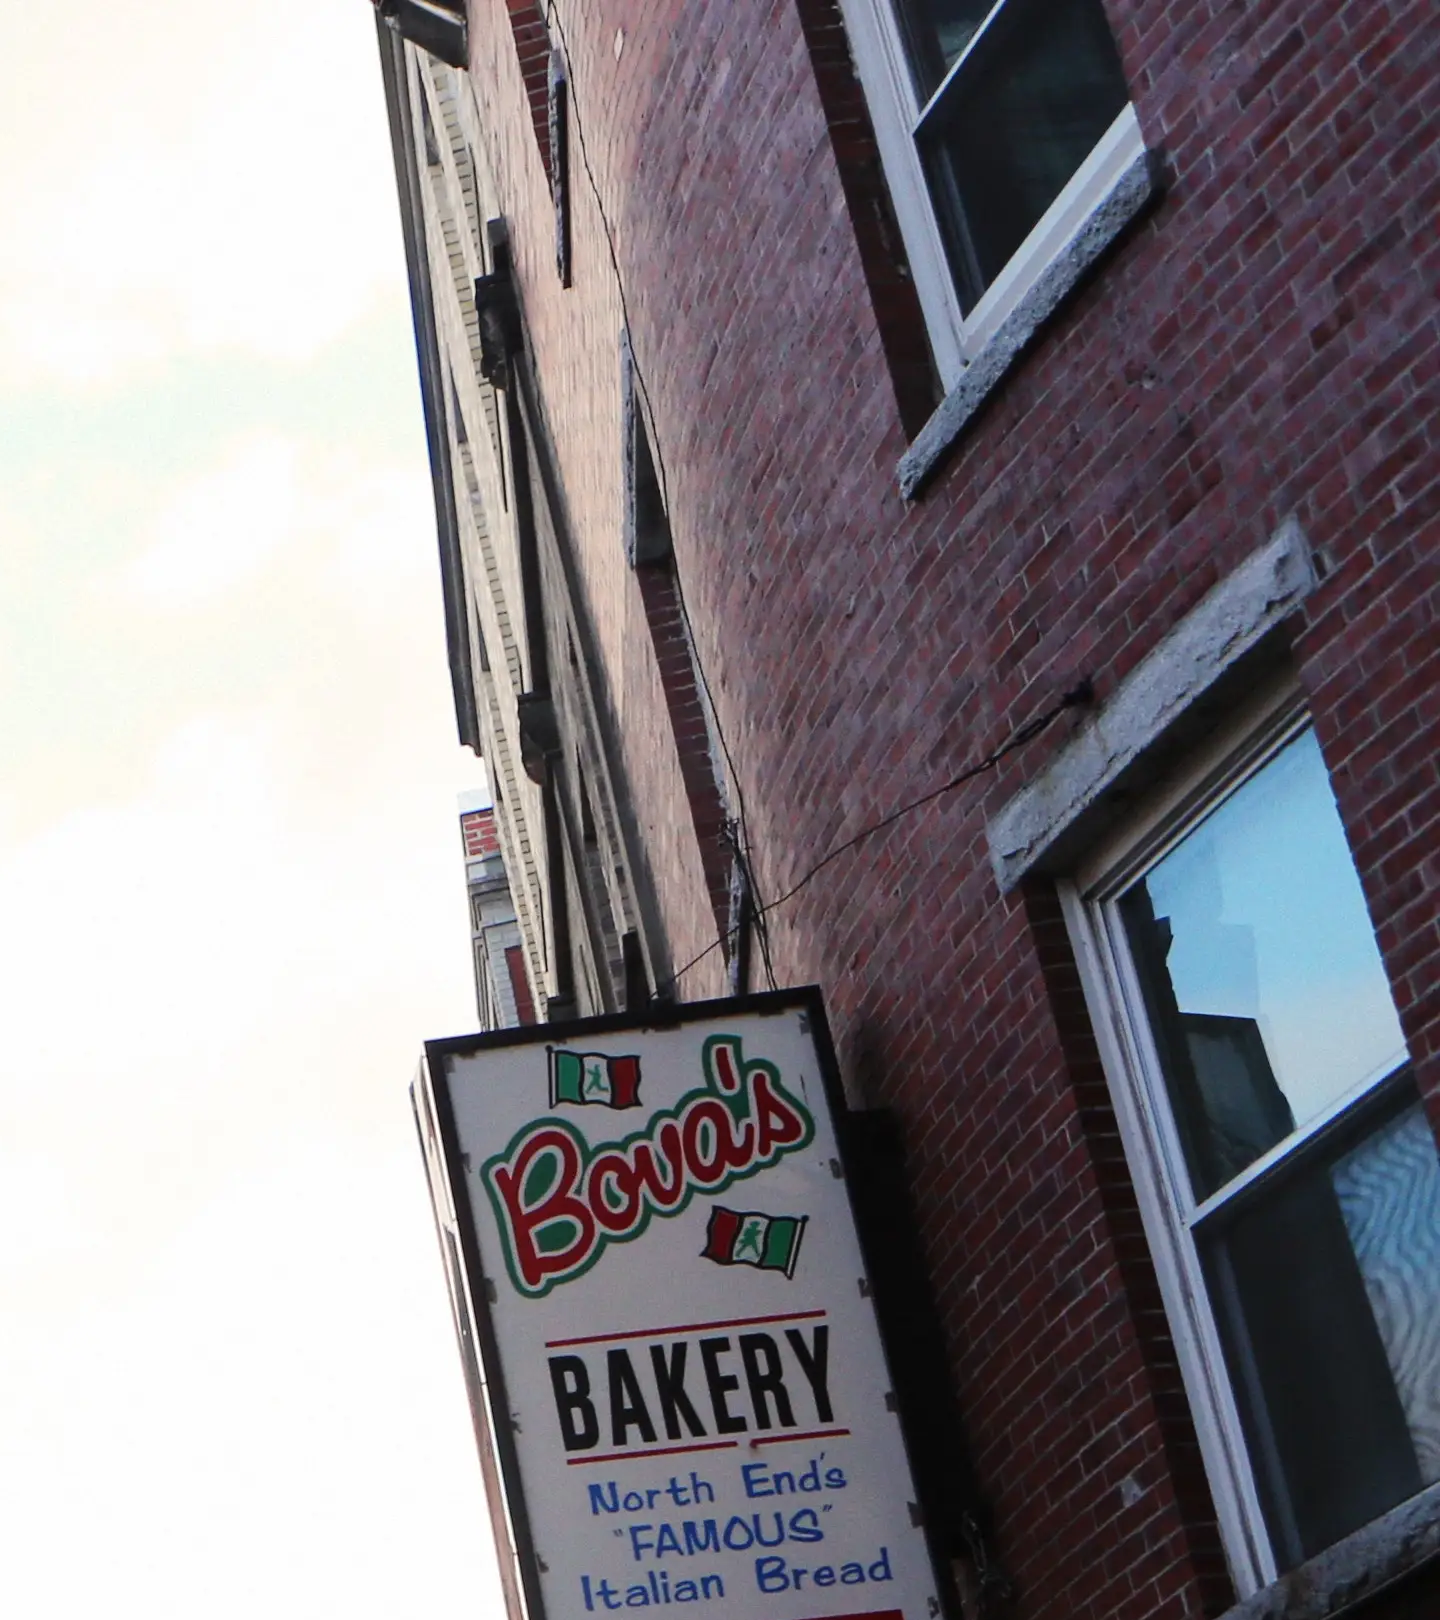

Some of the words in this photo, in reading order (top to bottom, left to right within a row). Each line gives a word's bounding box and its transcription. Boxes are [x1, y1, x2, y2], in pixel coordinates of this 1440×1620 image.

[483, 1034, 815, 1298] Bova's
[547, 1324, 838, 1453] BAKERY
[588, 1471, 714, 1516] North
[743, 1451, 848, 1498] End's
[612, 1504, 834, 1562] "FAMOUS"
[581, 1561, 724, 1612] Italian
[756, 1548, 893, 1594] Bread
